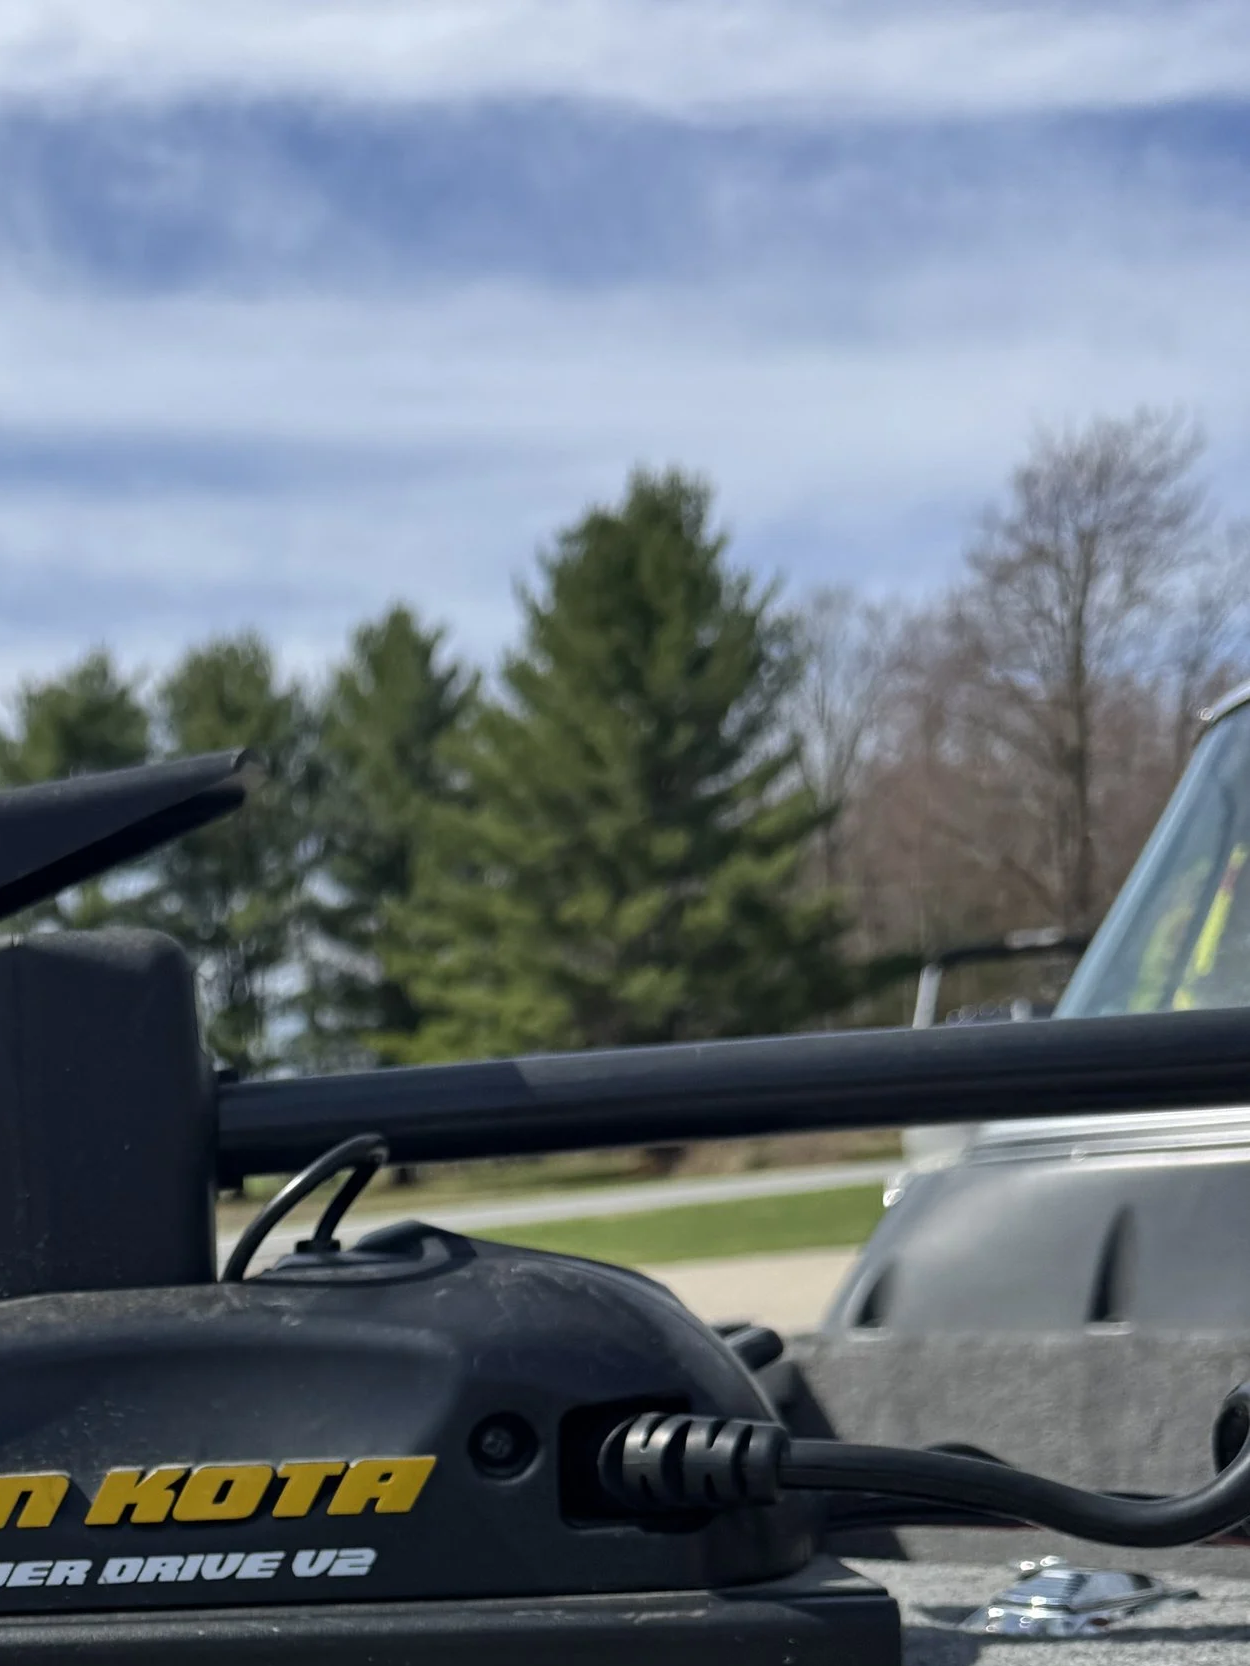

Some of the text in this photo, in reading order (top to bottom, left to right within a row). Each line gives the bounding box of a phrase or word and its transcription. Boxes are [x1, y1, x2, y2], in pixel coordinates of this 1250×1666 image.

[84, 1456, 437, 1526] KOTA
[97, 1551, 284, 1585] DRIVE
[291, 1547, 378, 1577] V2
